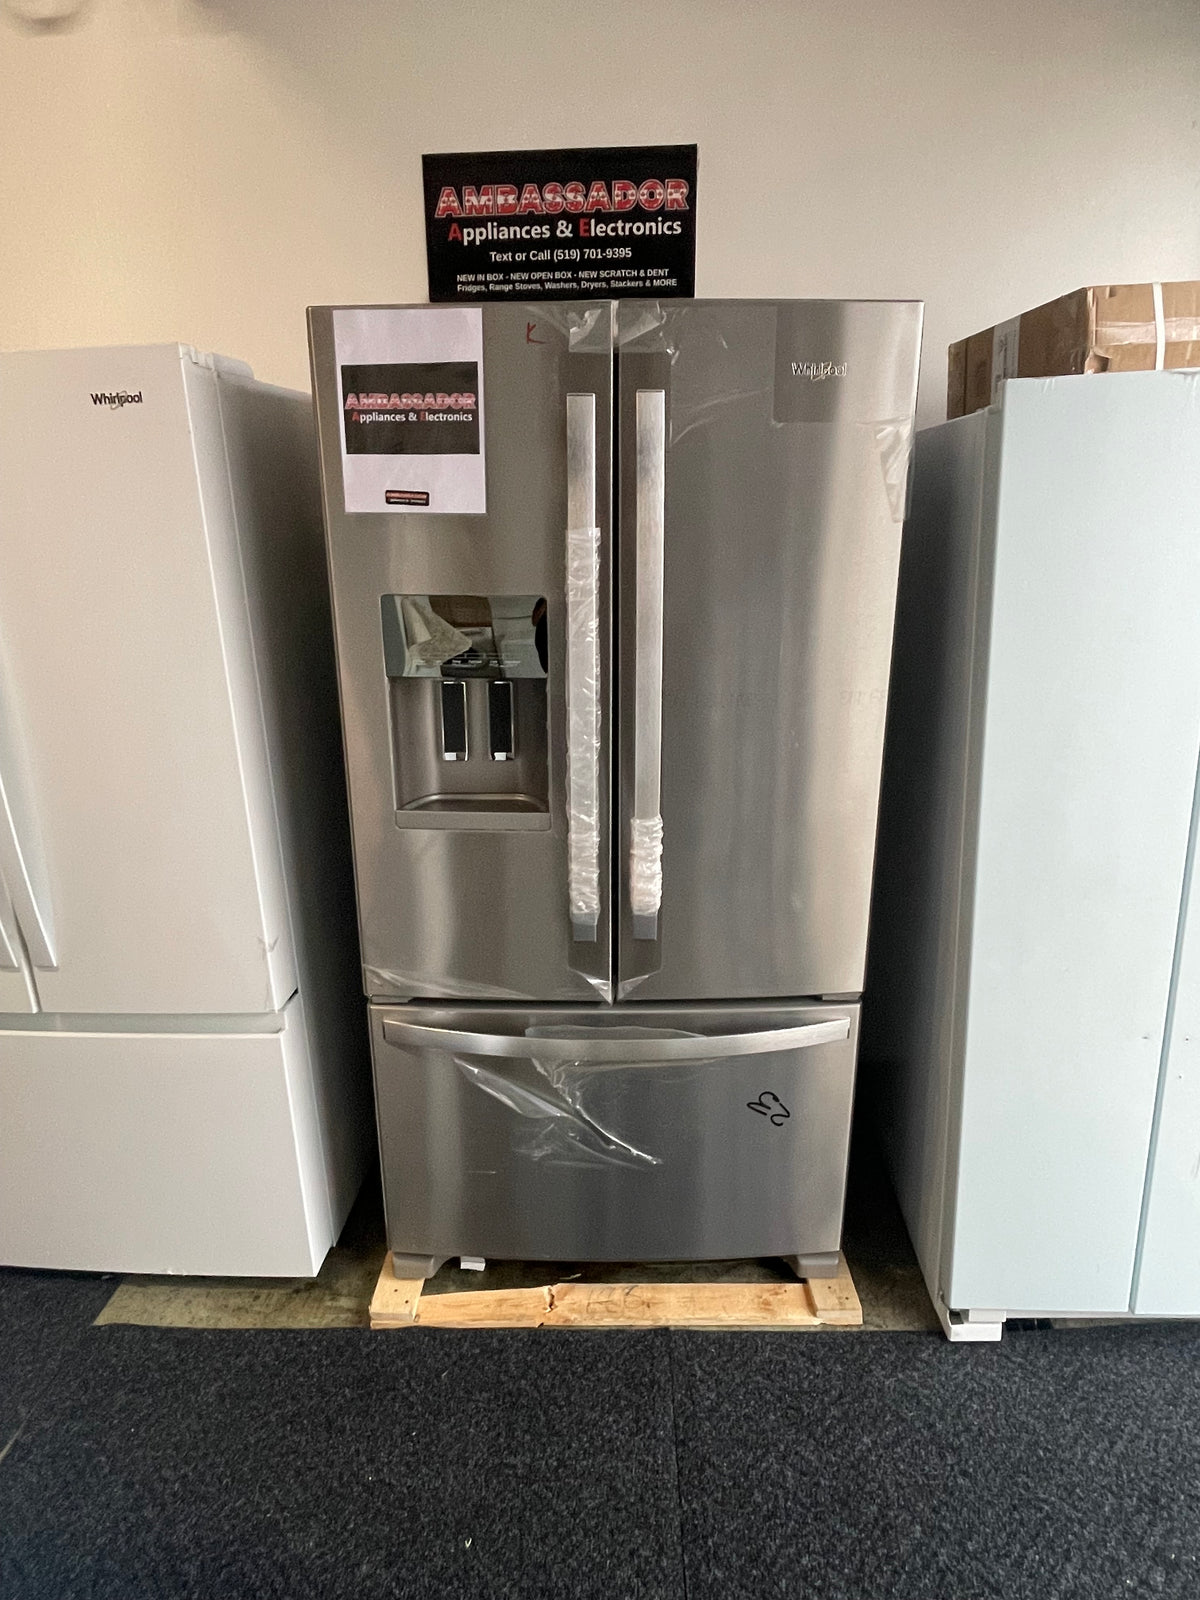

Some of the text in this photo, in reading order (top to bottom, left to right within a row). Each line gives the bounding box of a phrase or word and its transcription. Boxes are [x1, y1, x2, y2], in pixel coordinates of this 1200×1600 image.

[435, 178, 689, 217] AMBASSADOR
[447, 216, 682, 246] Appliances & Electronics
[489, 247, 632, 263] Text or Call (519) 701-9395
[456, 273, 476, 282] NEW
[477, 273, 485, 281] IN
[486, 272, 504, 281] BOX
[510, 272, 528, 280] NEW
[530, 271, 553, 280] OPEN
[554, 271, 573, 279] BOX
[578, 270, 598, 278] NEW
[599, 269, 638, 278] SCRATCH
[639, 269, 646, 278] &
[647, 268, 670, 277] DENT
[457, 278, 678, 293] Fridges, Range Stoves, Washers, Dryers, Stackers & MORE
[791, 362, 848, 381] Whirlpool
[90, 391, 142, 409] Whirlpool
[352, 411, 473, 424] Appliances & Electronics
